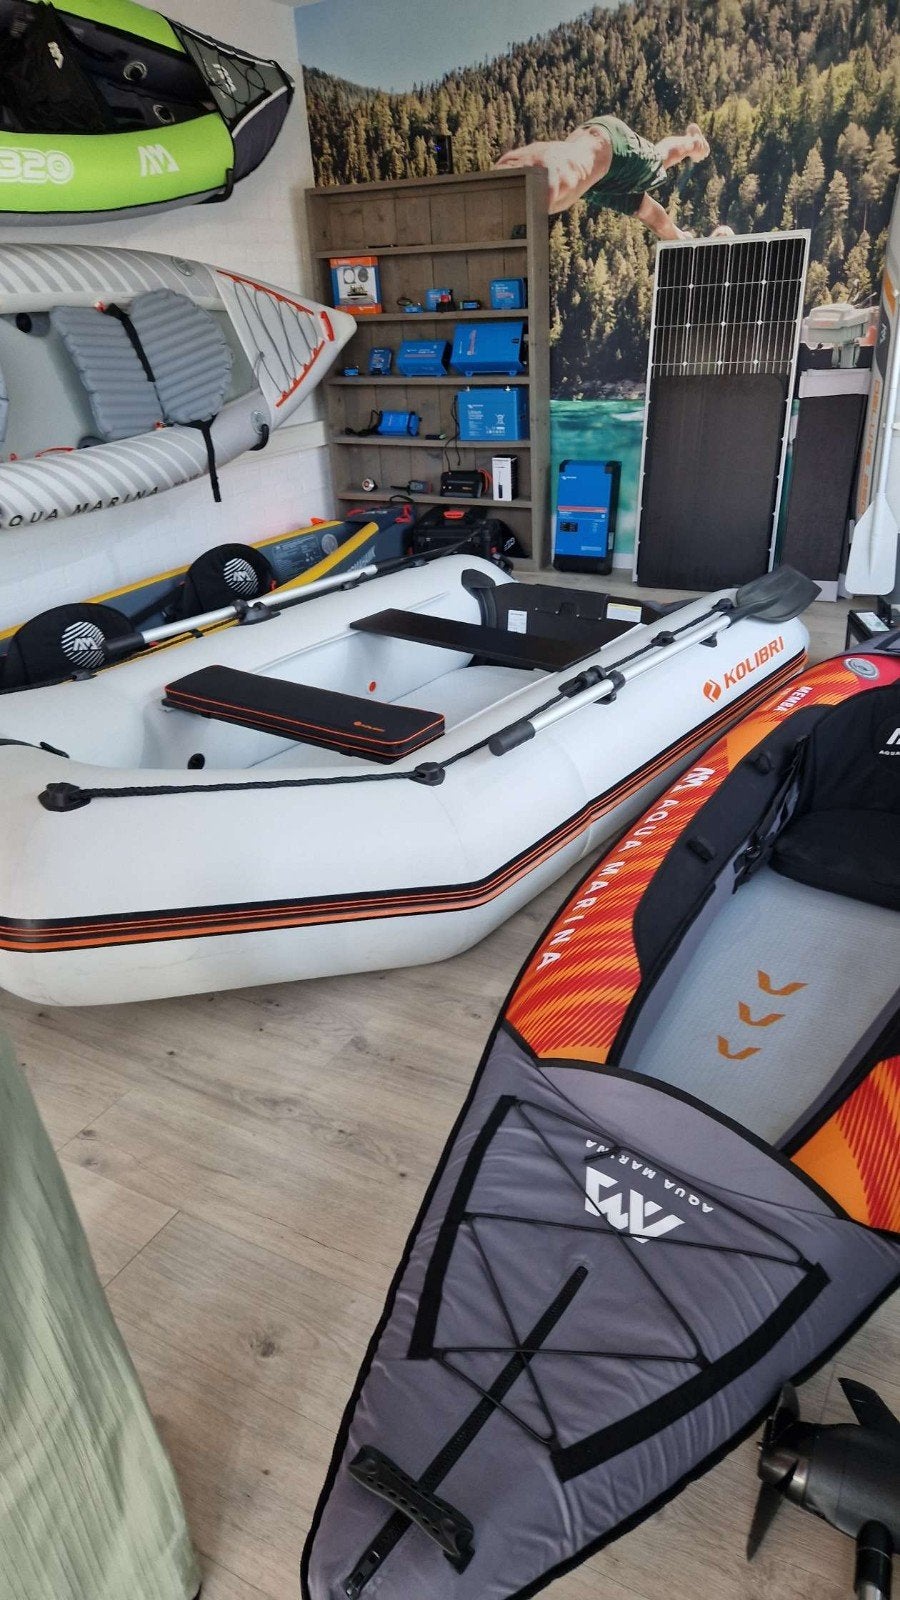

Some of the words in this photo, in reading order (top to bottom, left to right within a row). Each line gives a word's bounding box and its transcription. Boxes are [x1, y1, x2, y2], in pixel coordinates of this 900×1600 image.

[0, 147, 74, 184] 320
[0, 508, 59, 529] QUA
[72, 486, 159, 516] MARINA
[723, 636, 784, 689] KOLIBRI
[618, 799, 680, 853] AQUA
[536, 861, 626, 971] MARINA
[585, 1139, 657, 1179] MARNA
[663, 1178, 714, 1213] AQUA
